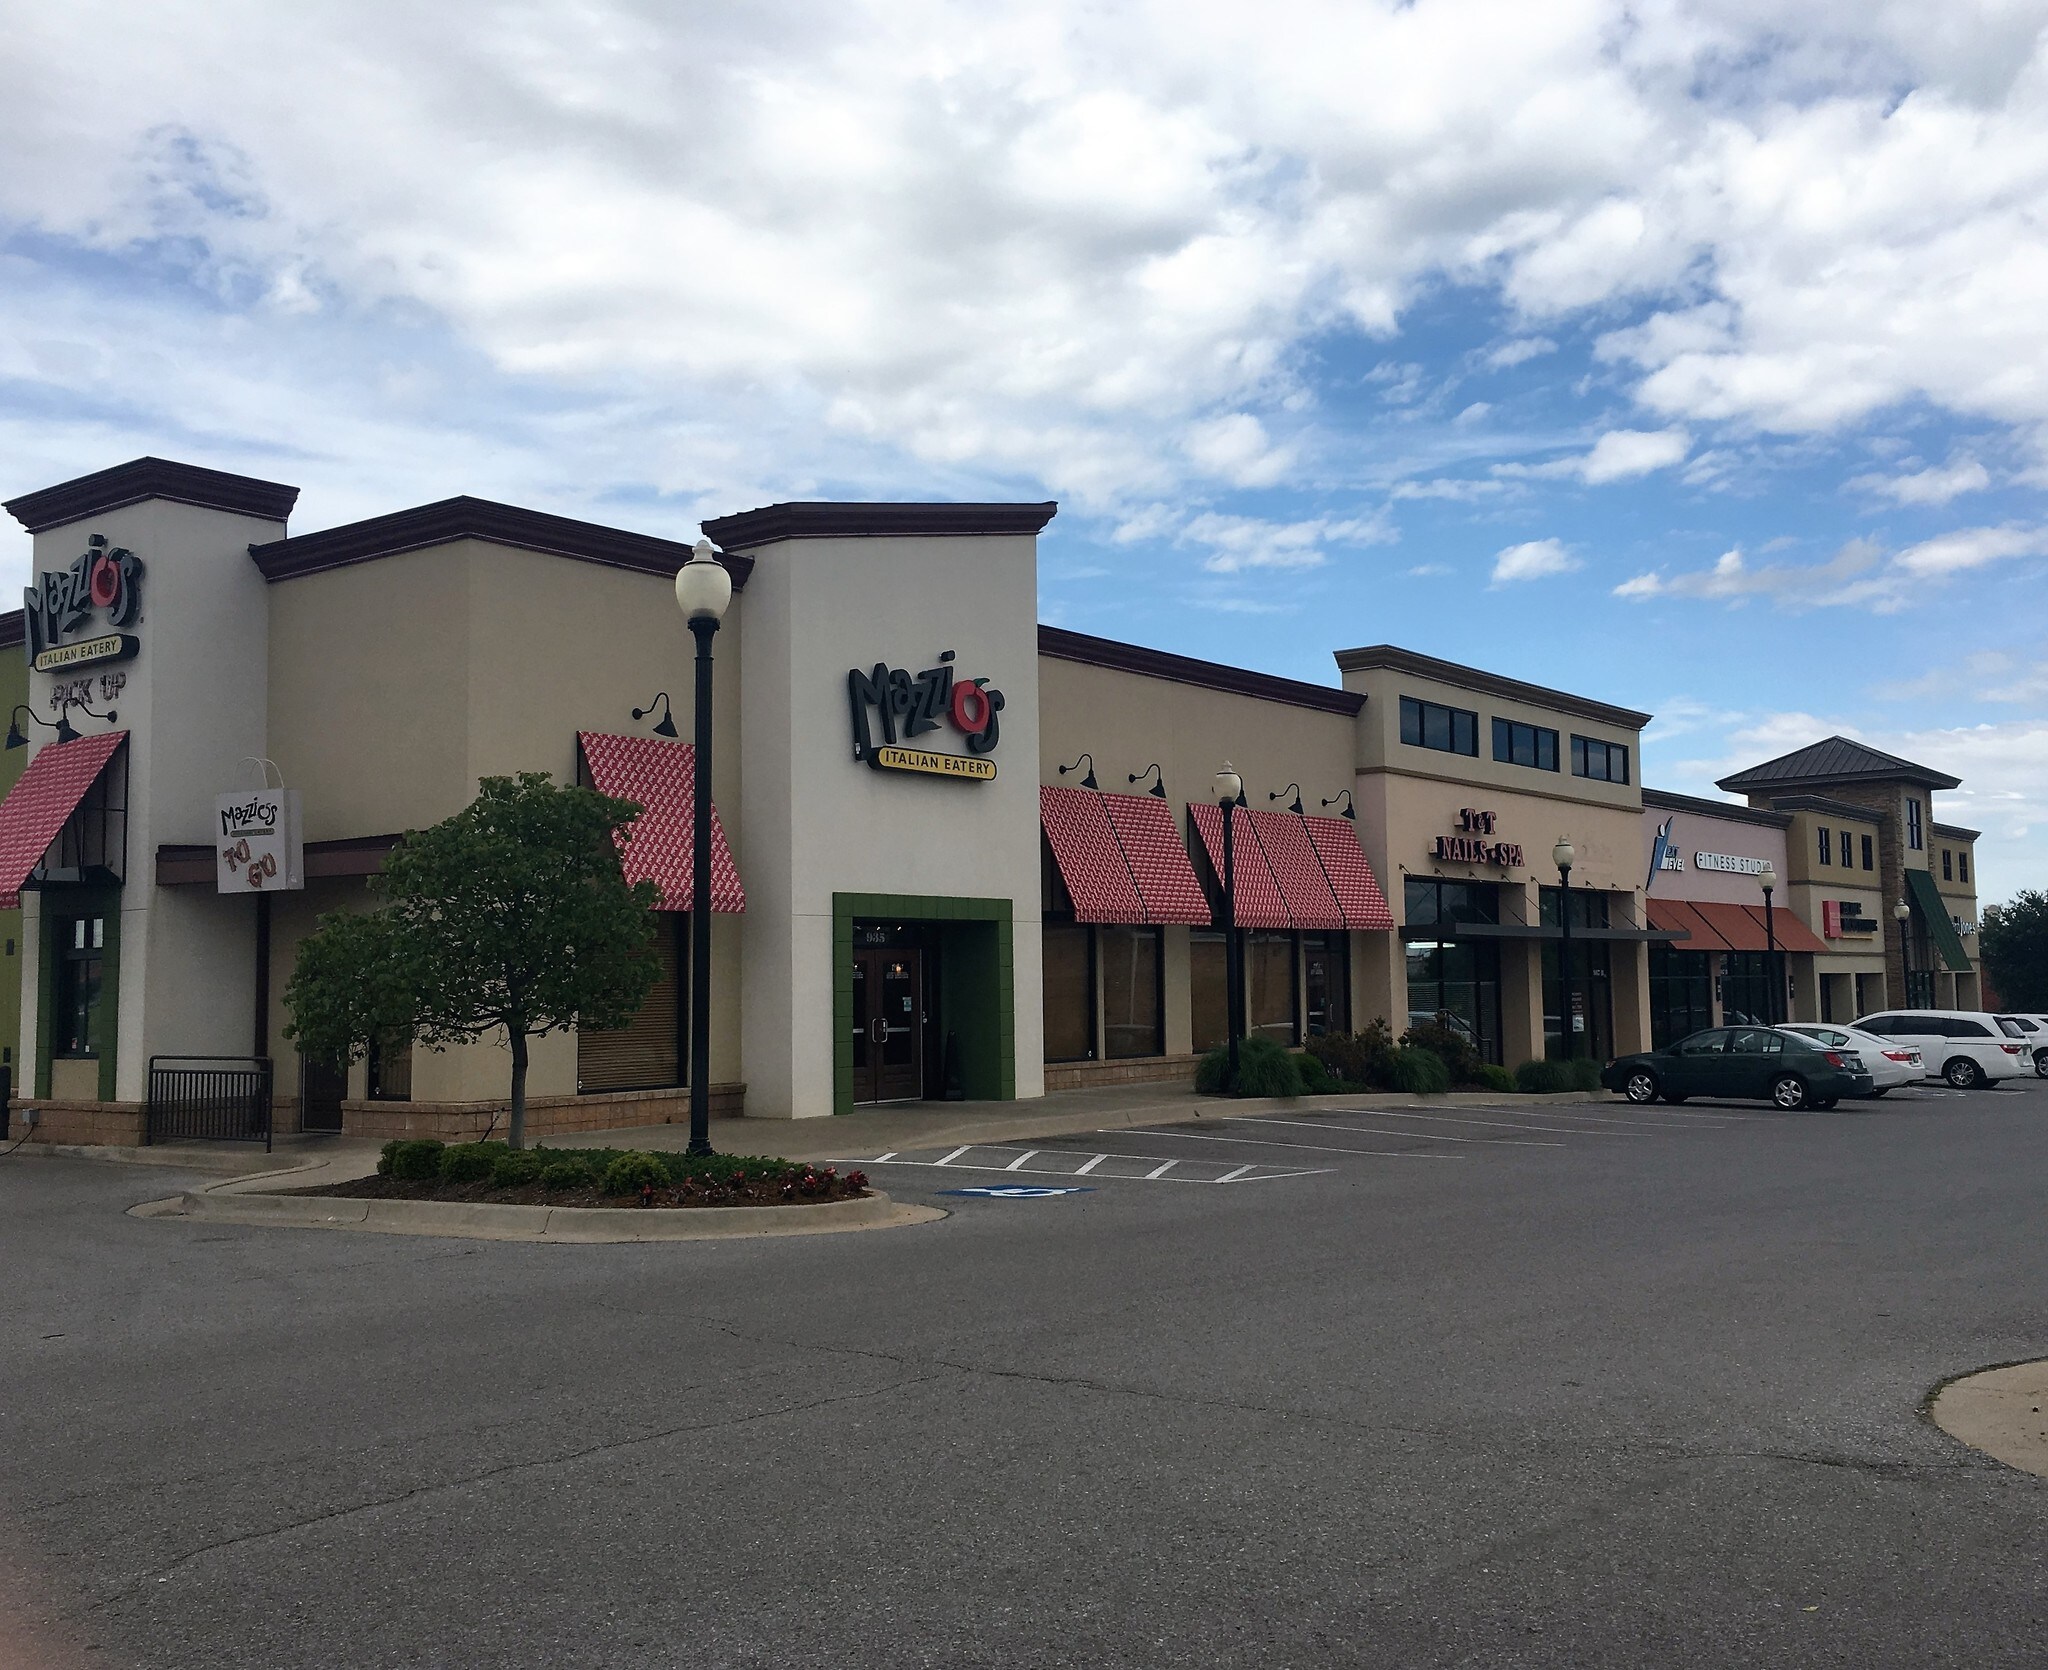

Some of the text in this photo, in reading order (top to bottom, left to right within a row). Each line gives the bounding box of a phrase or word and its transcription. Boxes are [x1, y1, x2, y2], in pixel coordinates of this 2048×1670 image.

[39, 639, 118, 667] ITALIAN EATERY
[50, 671, 127, 711] PICK UP
[885, 750, 990, 775] ITALIAN EATERY
[1461, 807, 1496, 834] T&T
[223, 838, 251, 872] TO
[1436, 836, 1525, 867] NAILS SPA
[1698, 852, 1735, 871] FITNESS
[247, 852, 276, 887] GO
